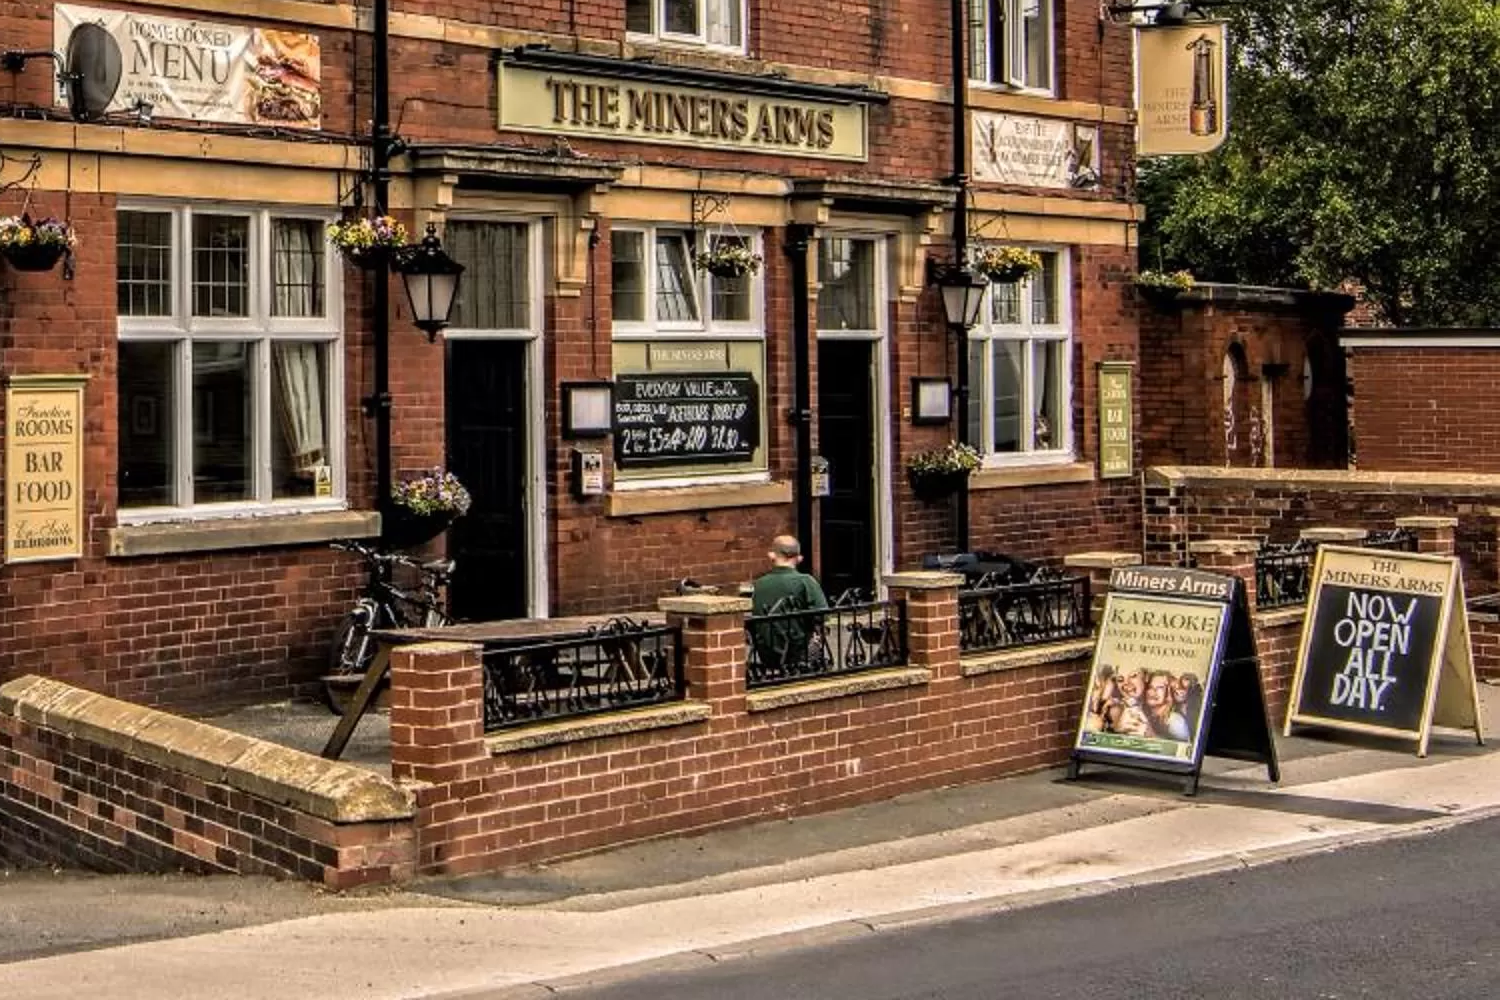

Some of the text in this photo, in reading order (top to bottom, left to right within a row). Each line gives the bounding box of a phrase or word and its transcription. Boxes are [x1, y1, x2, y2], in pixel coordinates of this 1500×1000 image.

[128, 39, 231, 85] MENU
[545, 77, 835, 149] THE MINERS ARMS
[15, 419, 73, 437] ROOMS
[25, 451, 63, 472] BAR
[15, 480, 72, 504] FOOD
[14, 536, 73, 549] BEDROOMS
[1370, 559, 1401, 575] THE
[1115, 571, 1227, 595] Miners Arms
[1324, 569, 1444, 594] MINERS ARMS
[1111, 608, 1215, 633] KARAOKE
[1347, 592, 1417, 625] NOW
[1116, 642, 1134, 653] ALL
[1334, 618, 1411, 655] OPEN
[1343, 647, 1397, 682] ALL
[1329, 673, 1394, 710] DAY.
